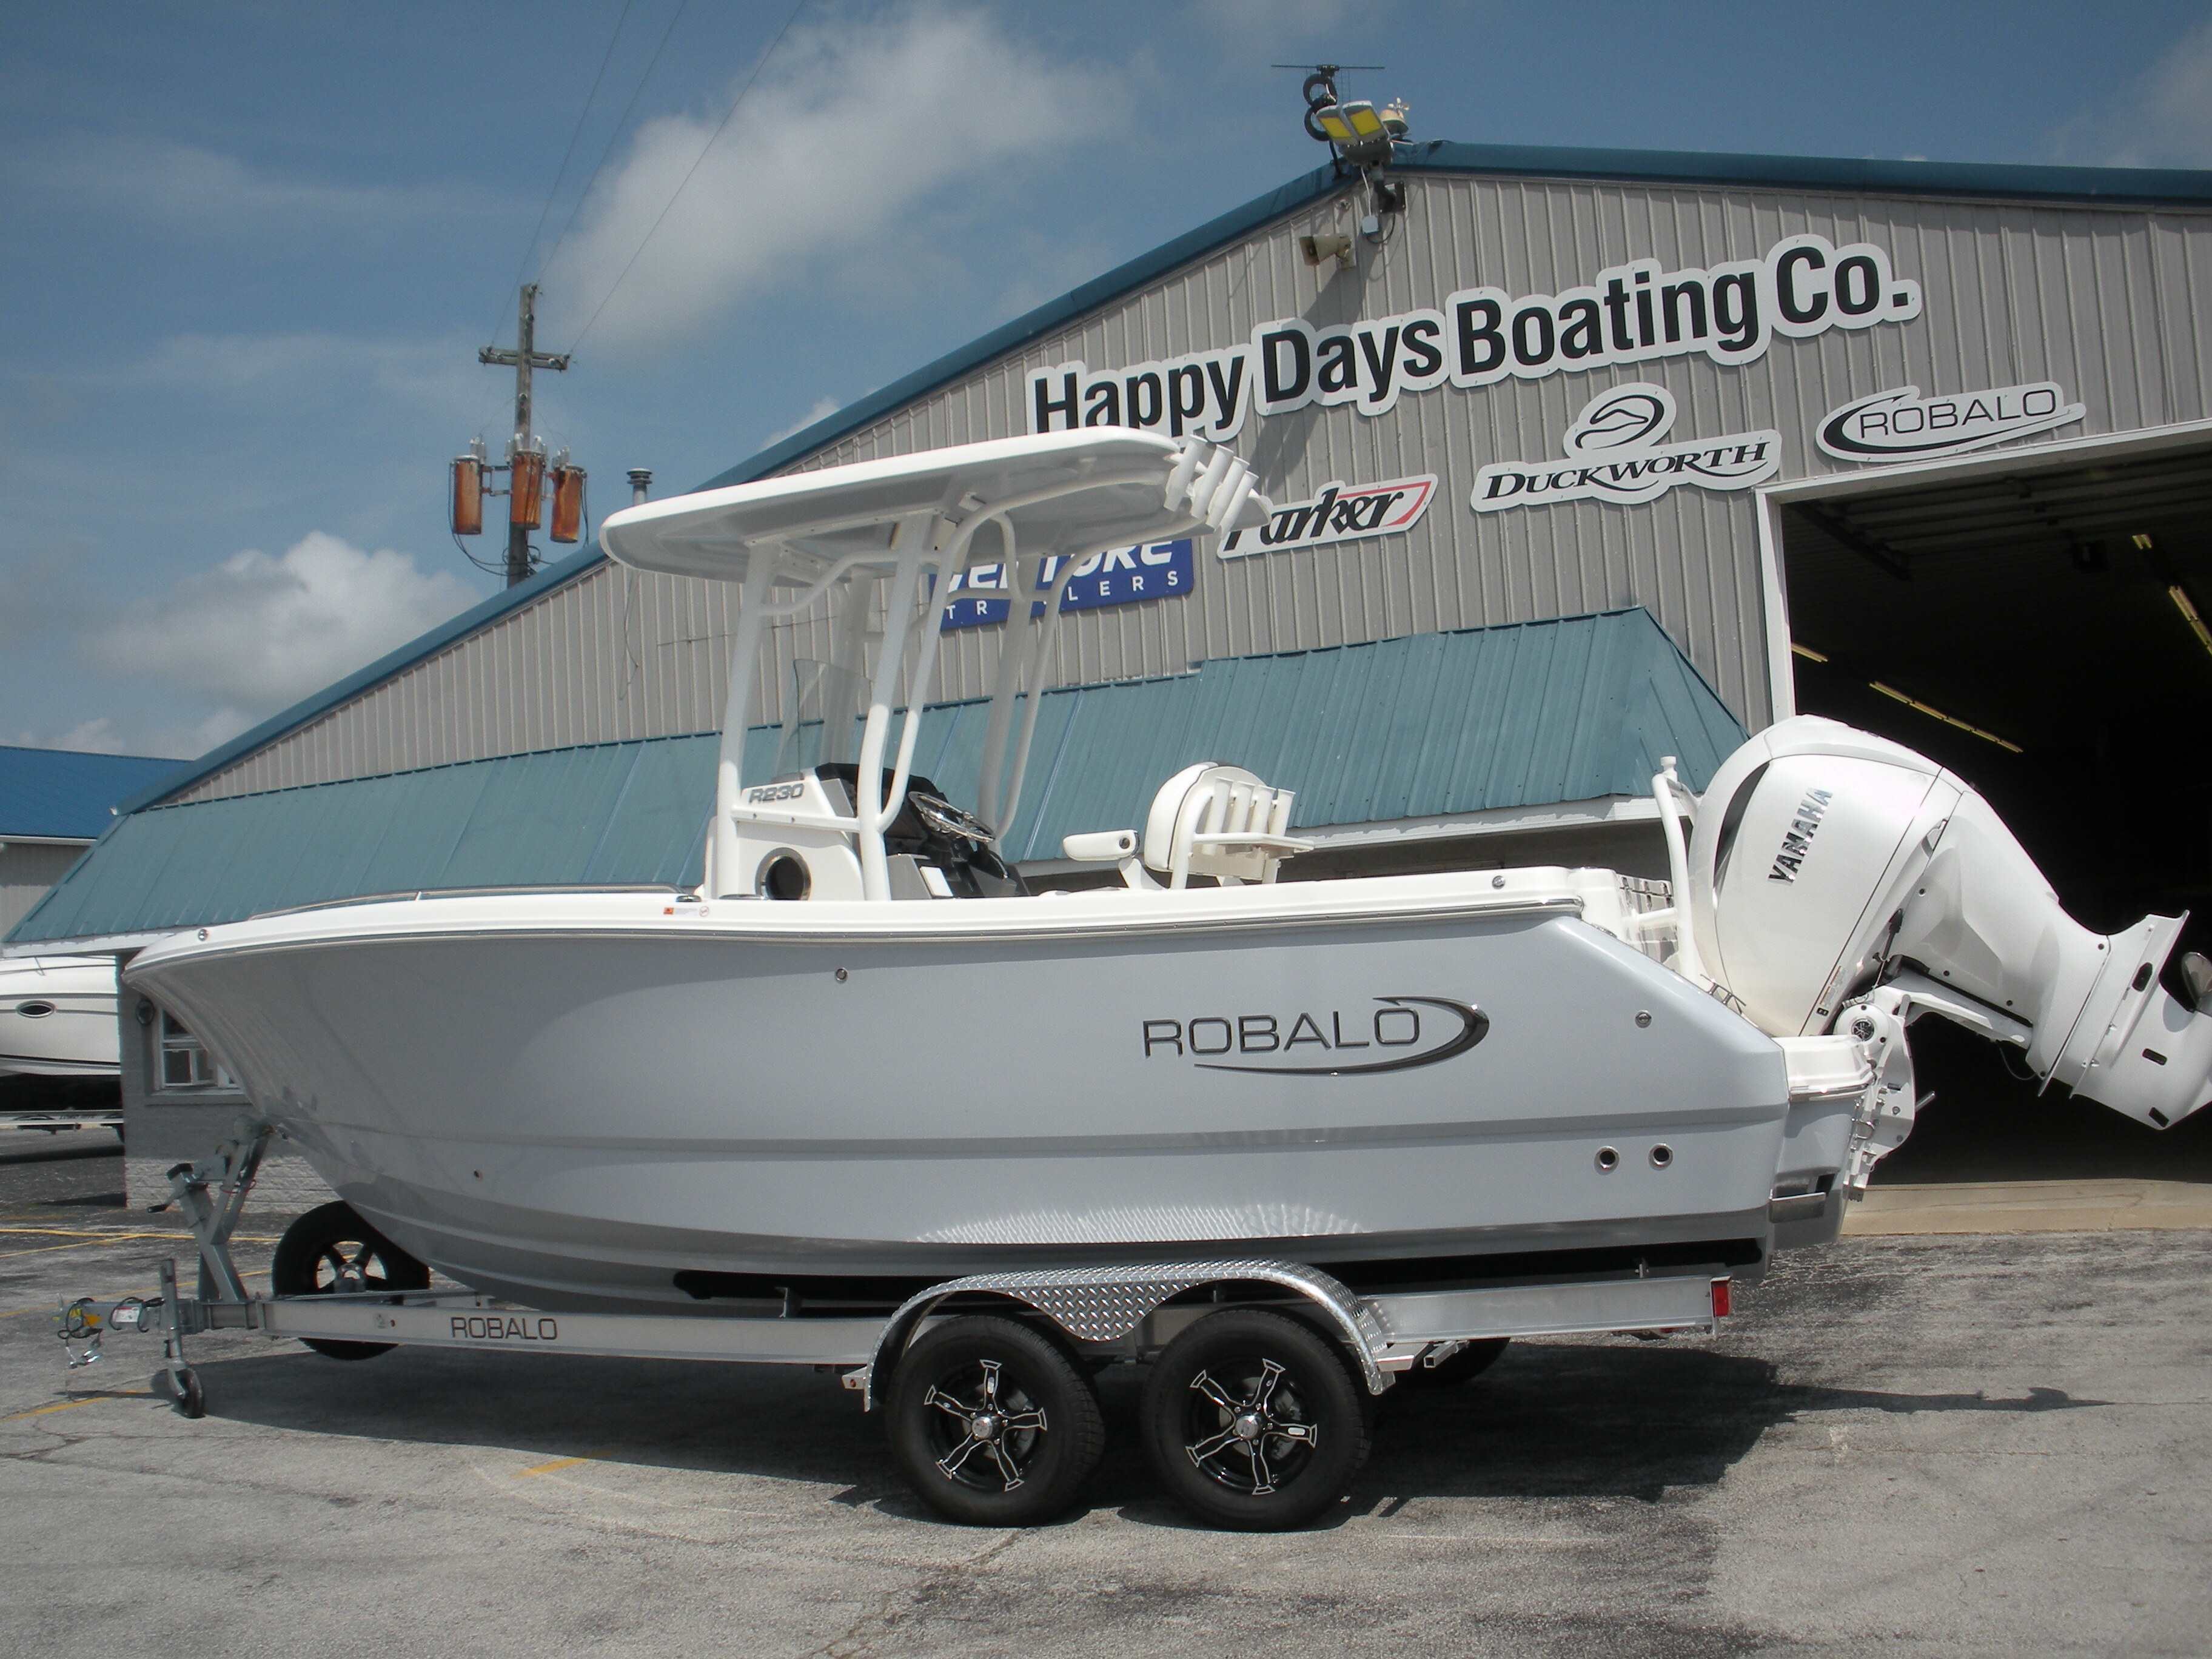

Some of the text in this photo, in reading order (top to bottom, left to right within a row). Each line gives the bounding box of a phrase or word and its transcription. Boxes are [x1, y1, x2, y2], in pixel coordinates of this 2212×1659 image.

[1034, 246, 1909, 437] Happy Days Boating Co.
[1859, 389, 2057, 438] ROBALO
[946, 571, 1179, 620] TRLERS
[749, 783, 805, 804] R230
[1768, 788, 1833, 884] YAMAHA
[1142, 1007, 1421, 1057] ROBALO
[451, 1316, 558, 1340] ROBALO
